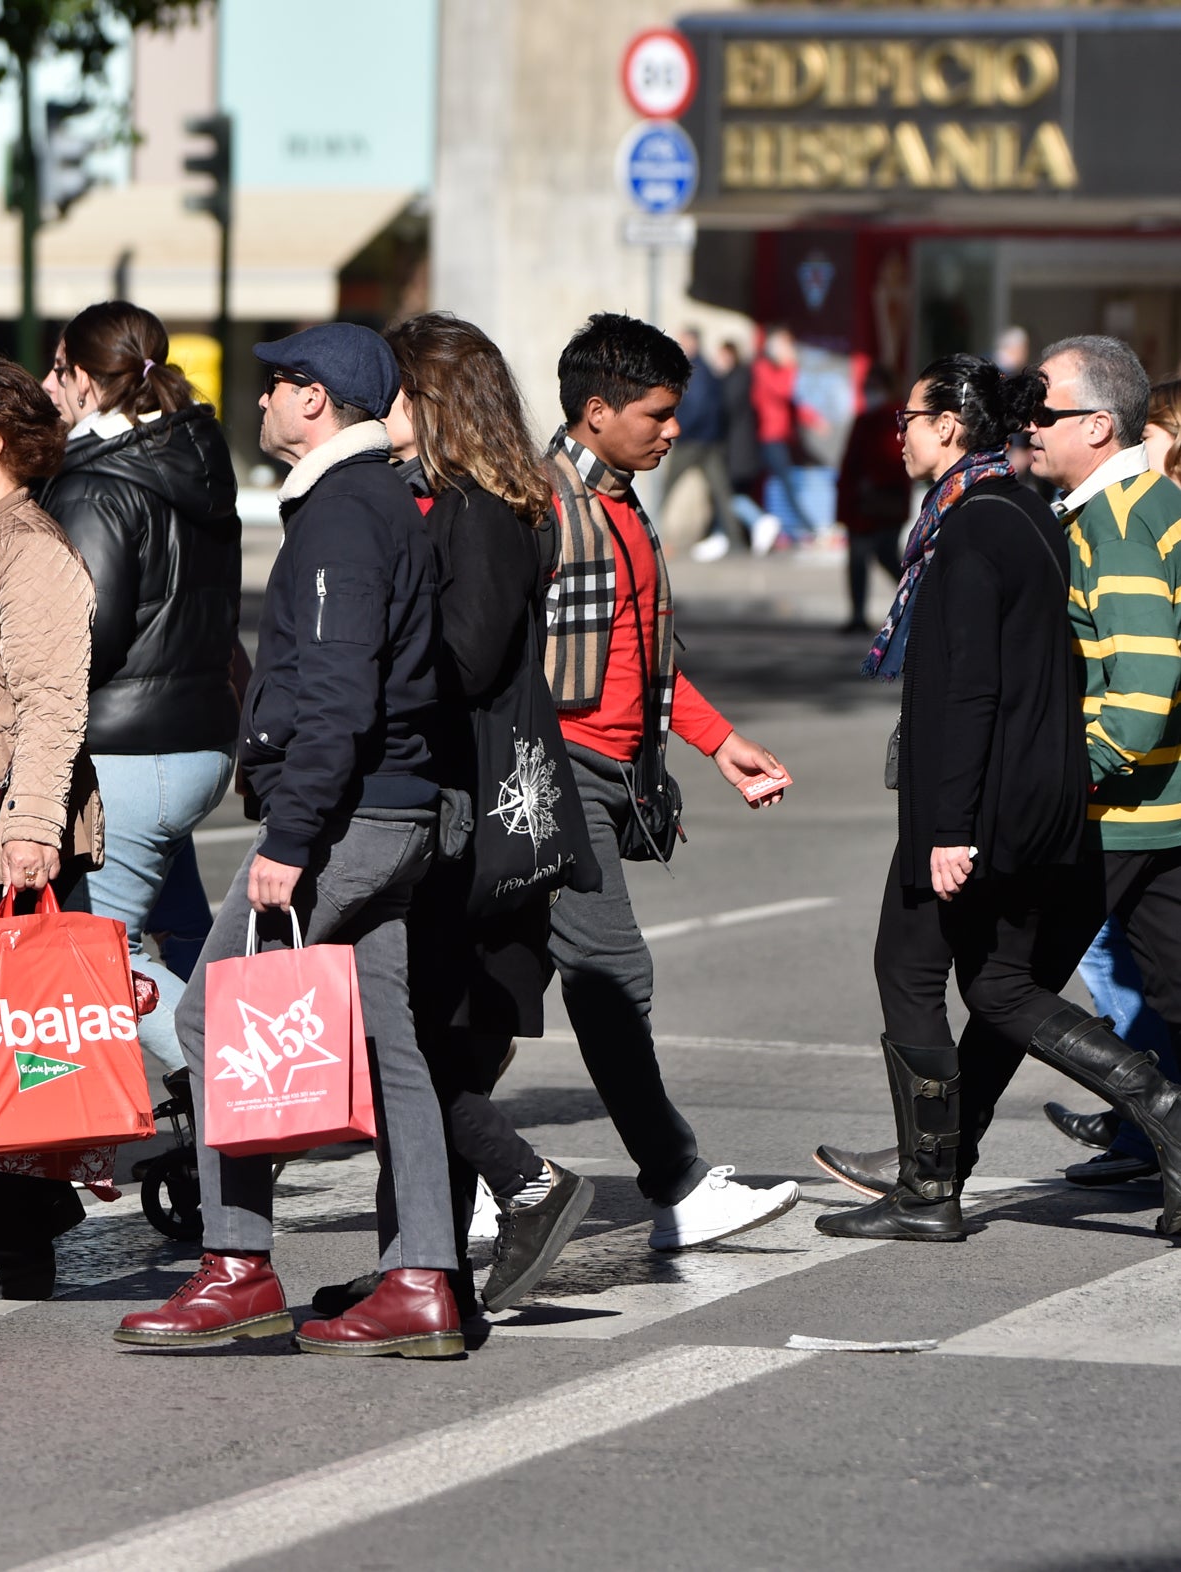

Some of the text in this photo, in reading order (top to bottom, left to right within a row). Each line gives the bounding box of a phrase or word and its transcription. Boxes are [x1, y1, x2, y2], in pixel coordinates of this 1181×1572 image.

[725, 39, 1059, 108] EDIFICIO
[724, 121, 1078, 189] HISPANIA
[216, 999, 325, 1090] M53
